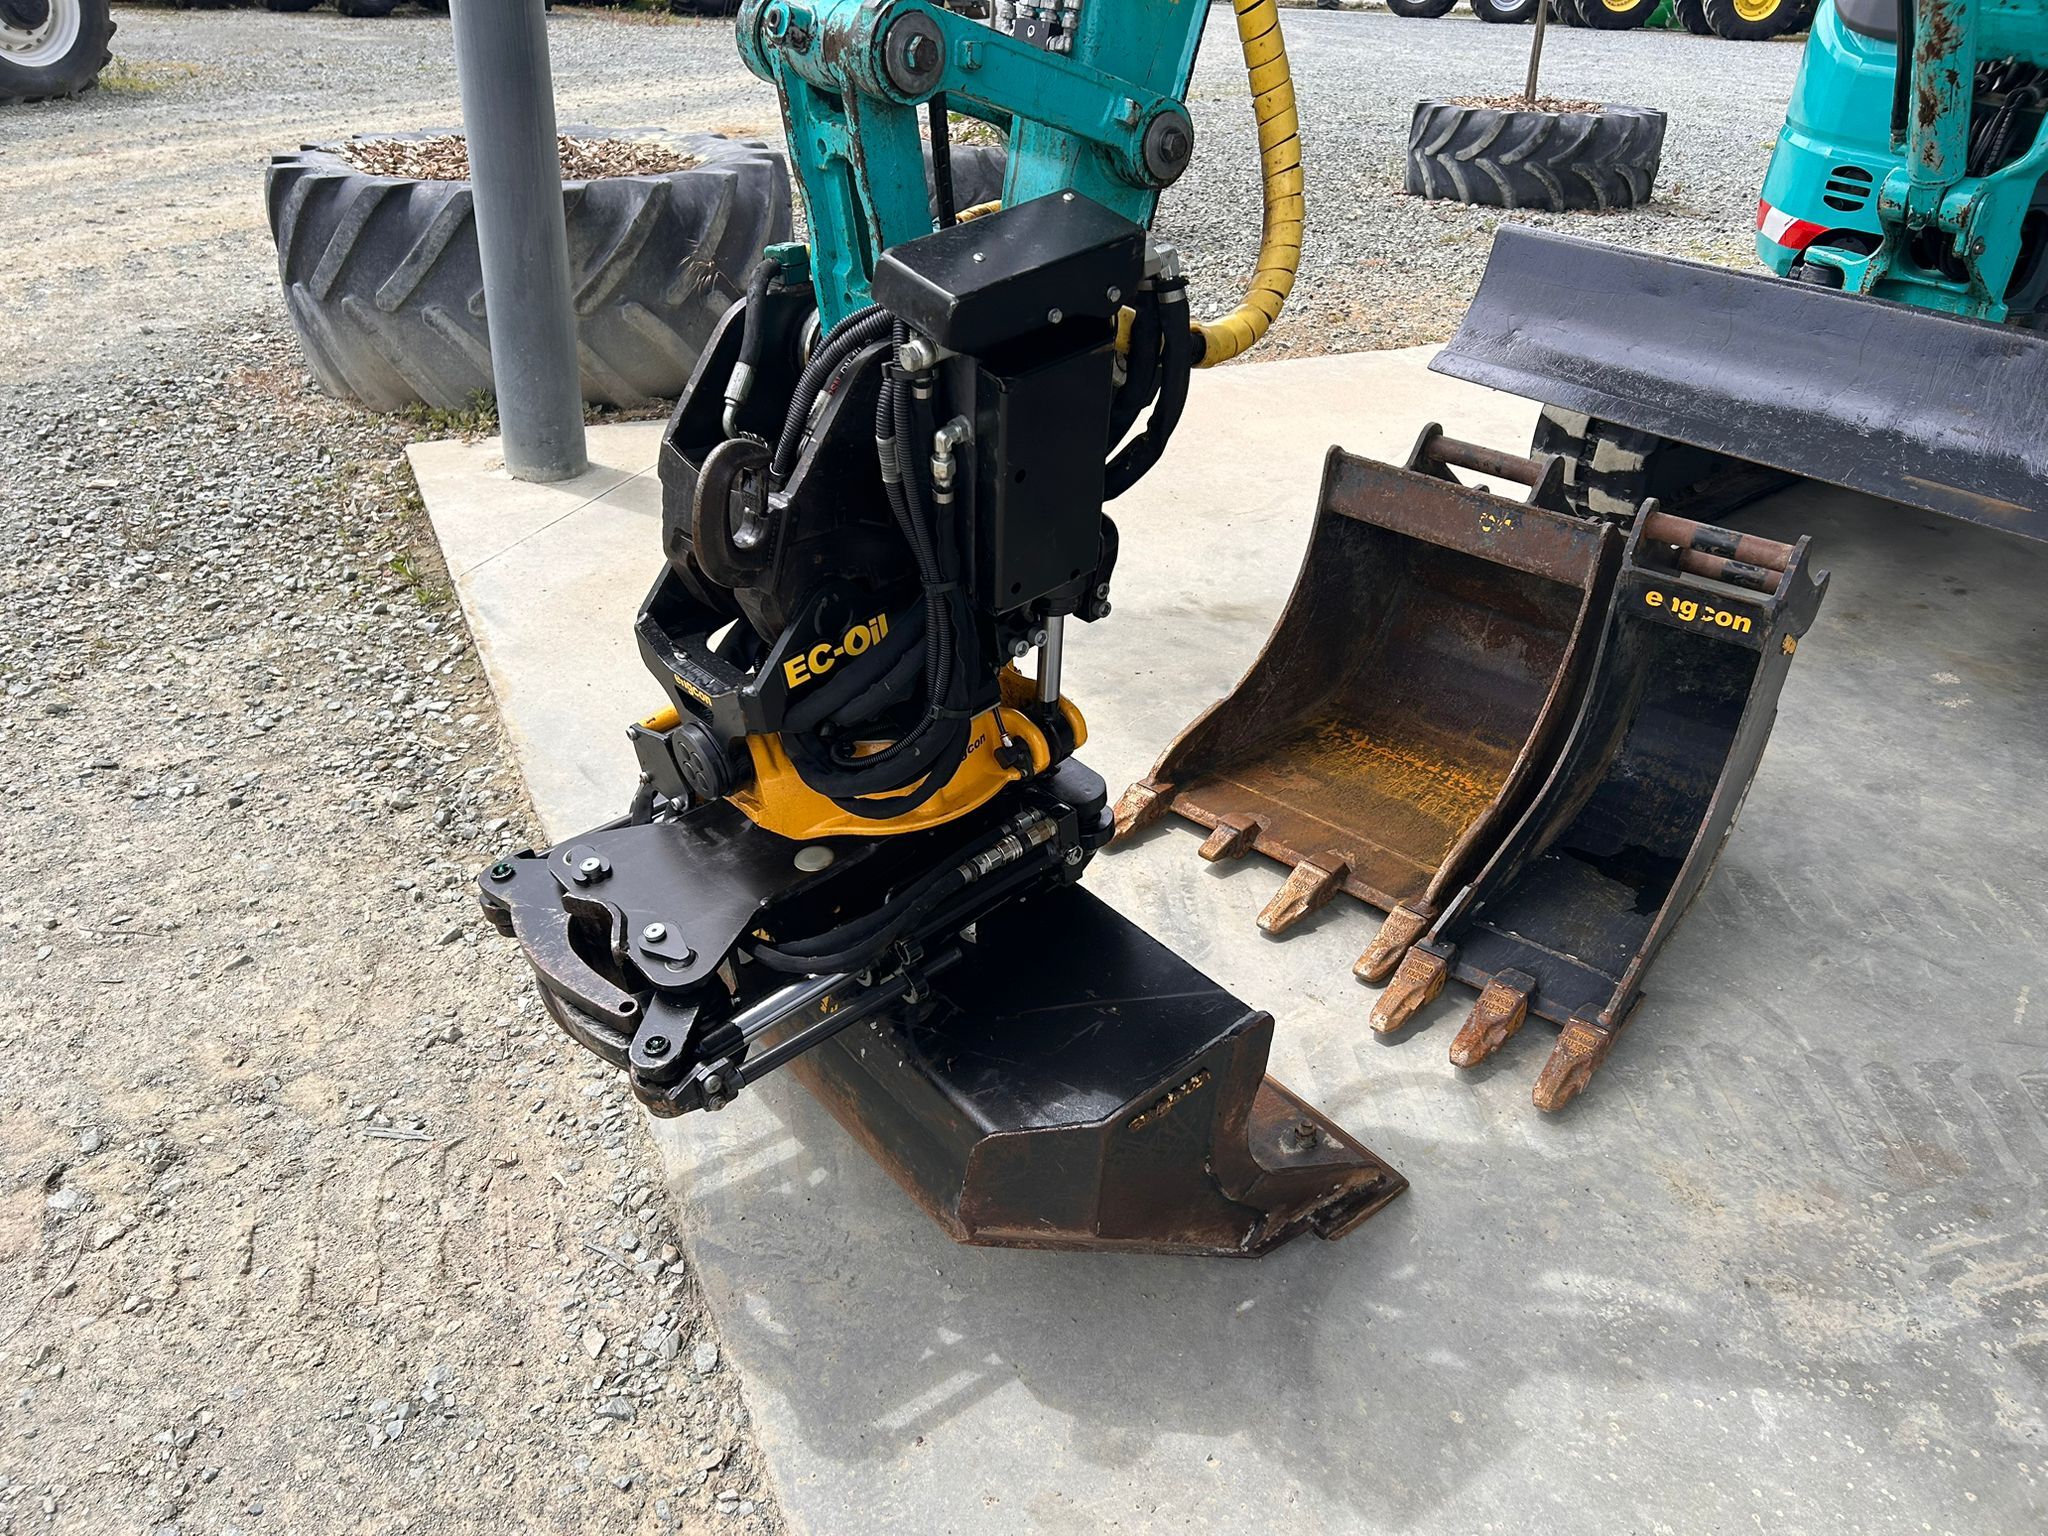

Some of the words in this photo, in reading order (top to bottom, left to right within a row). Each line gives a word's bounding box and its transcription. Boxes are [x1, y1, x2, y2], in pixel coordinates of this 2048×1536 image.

[783, 613, 889, 689] EC-Oil
[673, 673, 713, 707] engcon
[962, 734, 986, 761] con
